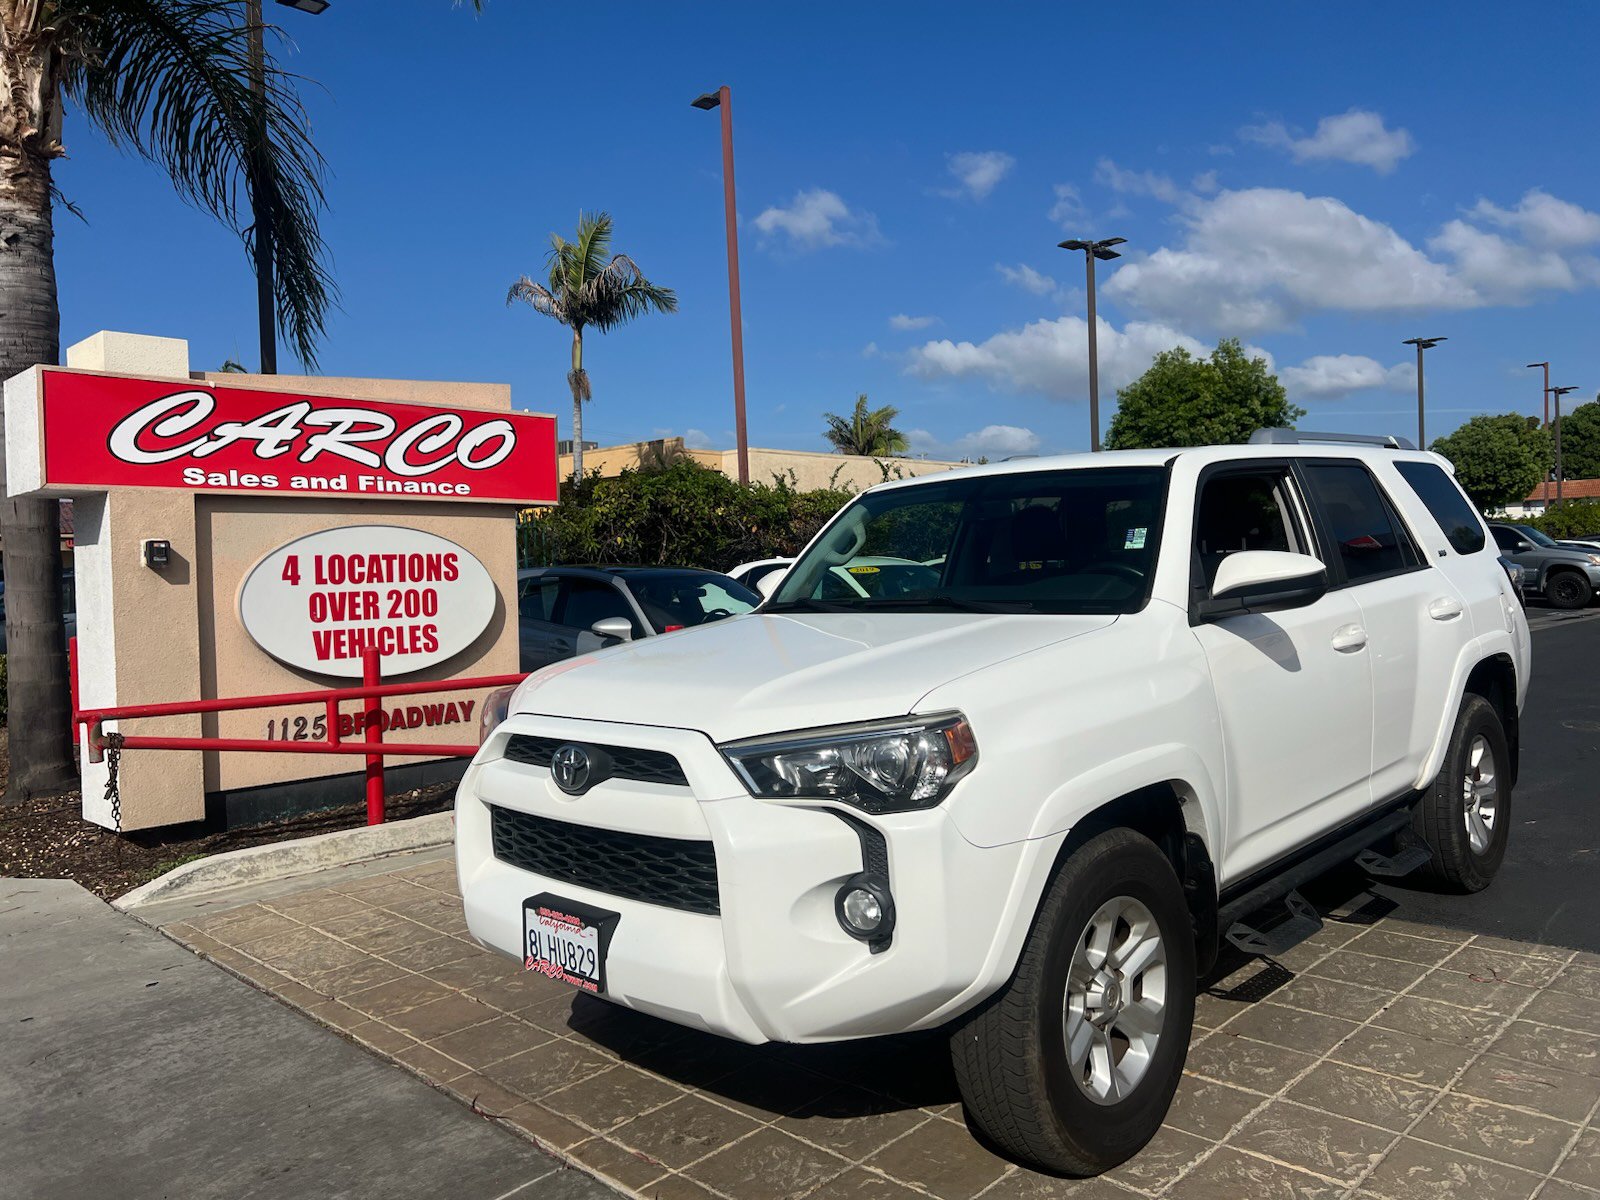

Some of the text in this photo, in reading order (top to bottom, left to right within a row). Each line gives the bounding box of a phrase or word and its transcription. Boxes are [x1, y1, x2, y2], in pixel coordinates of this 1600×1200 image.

[107, 390, 517, 477] CARCO
[182, 467, 471, 495] Sales and Finance
[281, 552, 459, 586] 4 LOCATIONS
[309, 588, 438, 623] OVER 200
[312, 624, 439, 661] VEHICLES
[267, 714, 327, 741] 1125
[529, 929, 595, 977] 8LHU829
